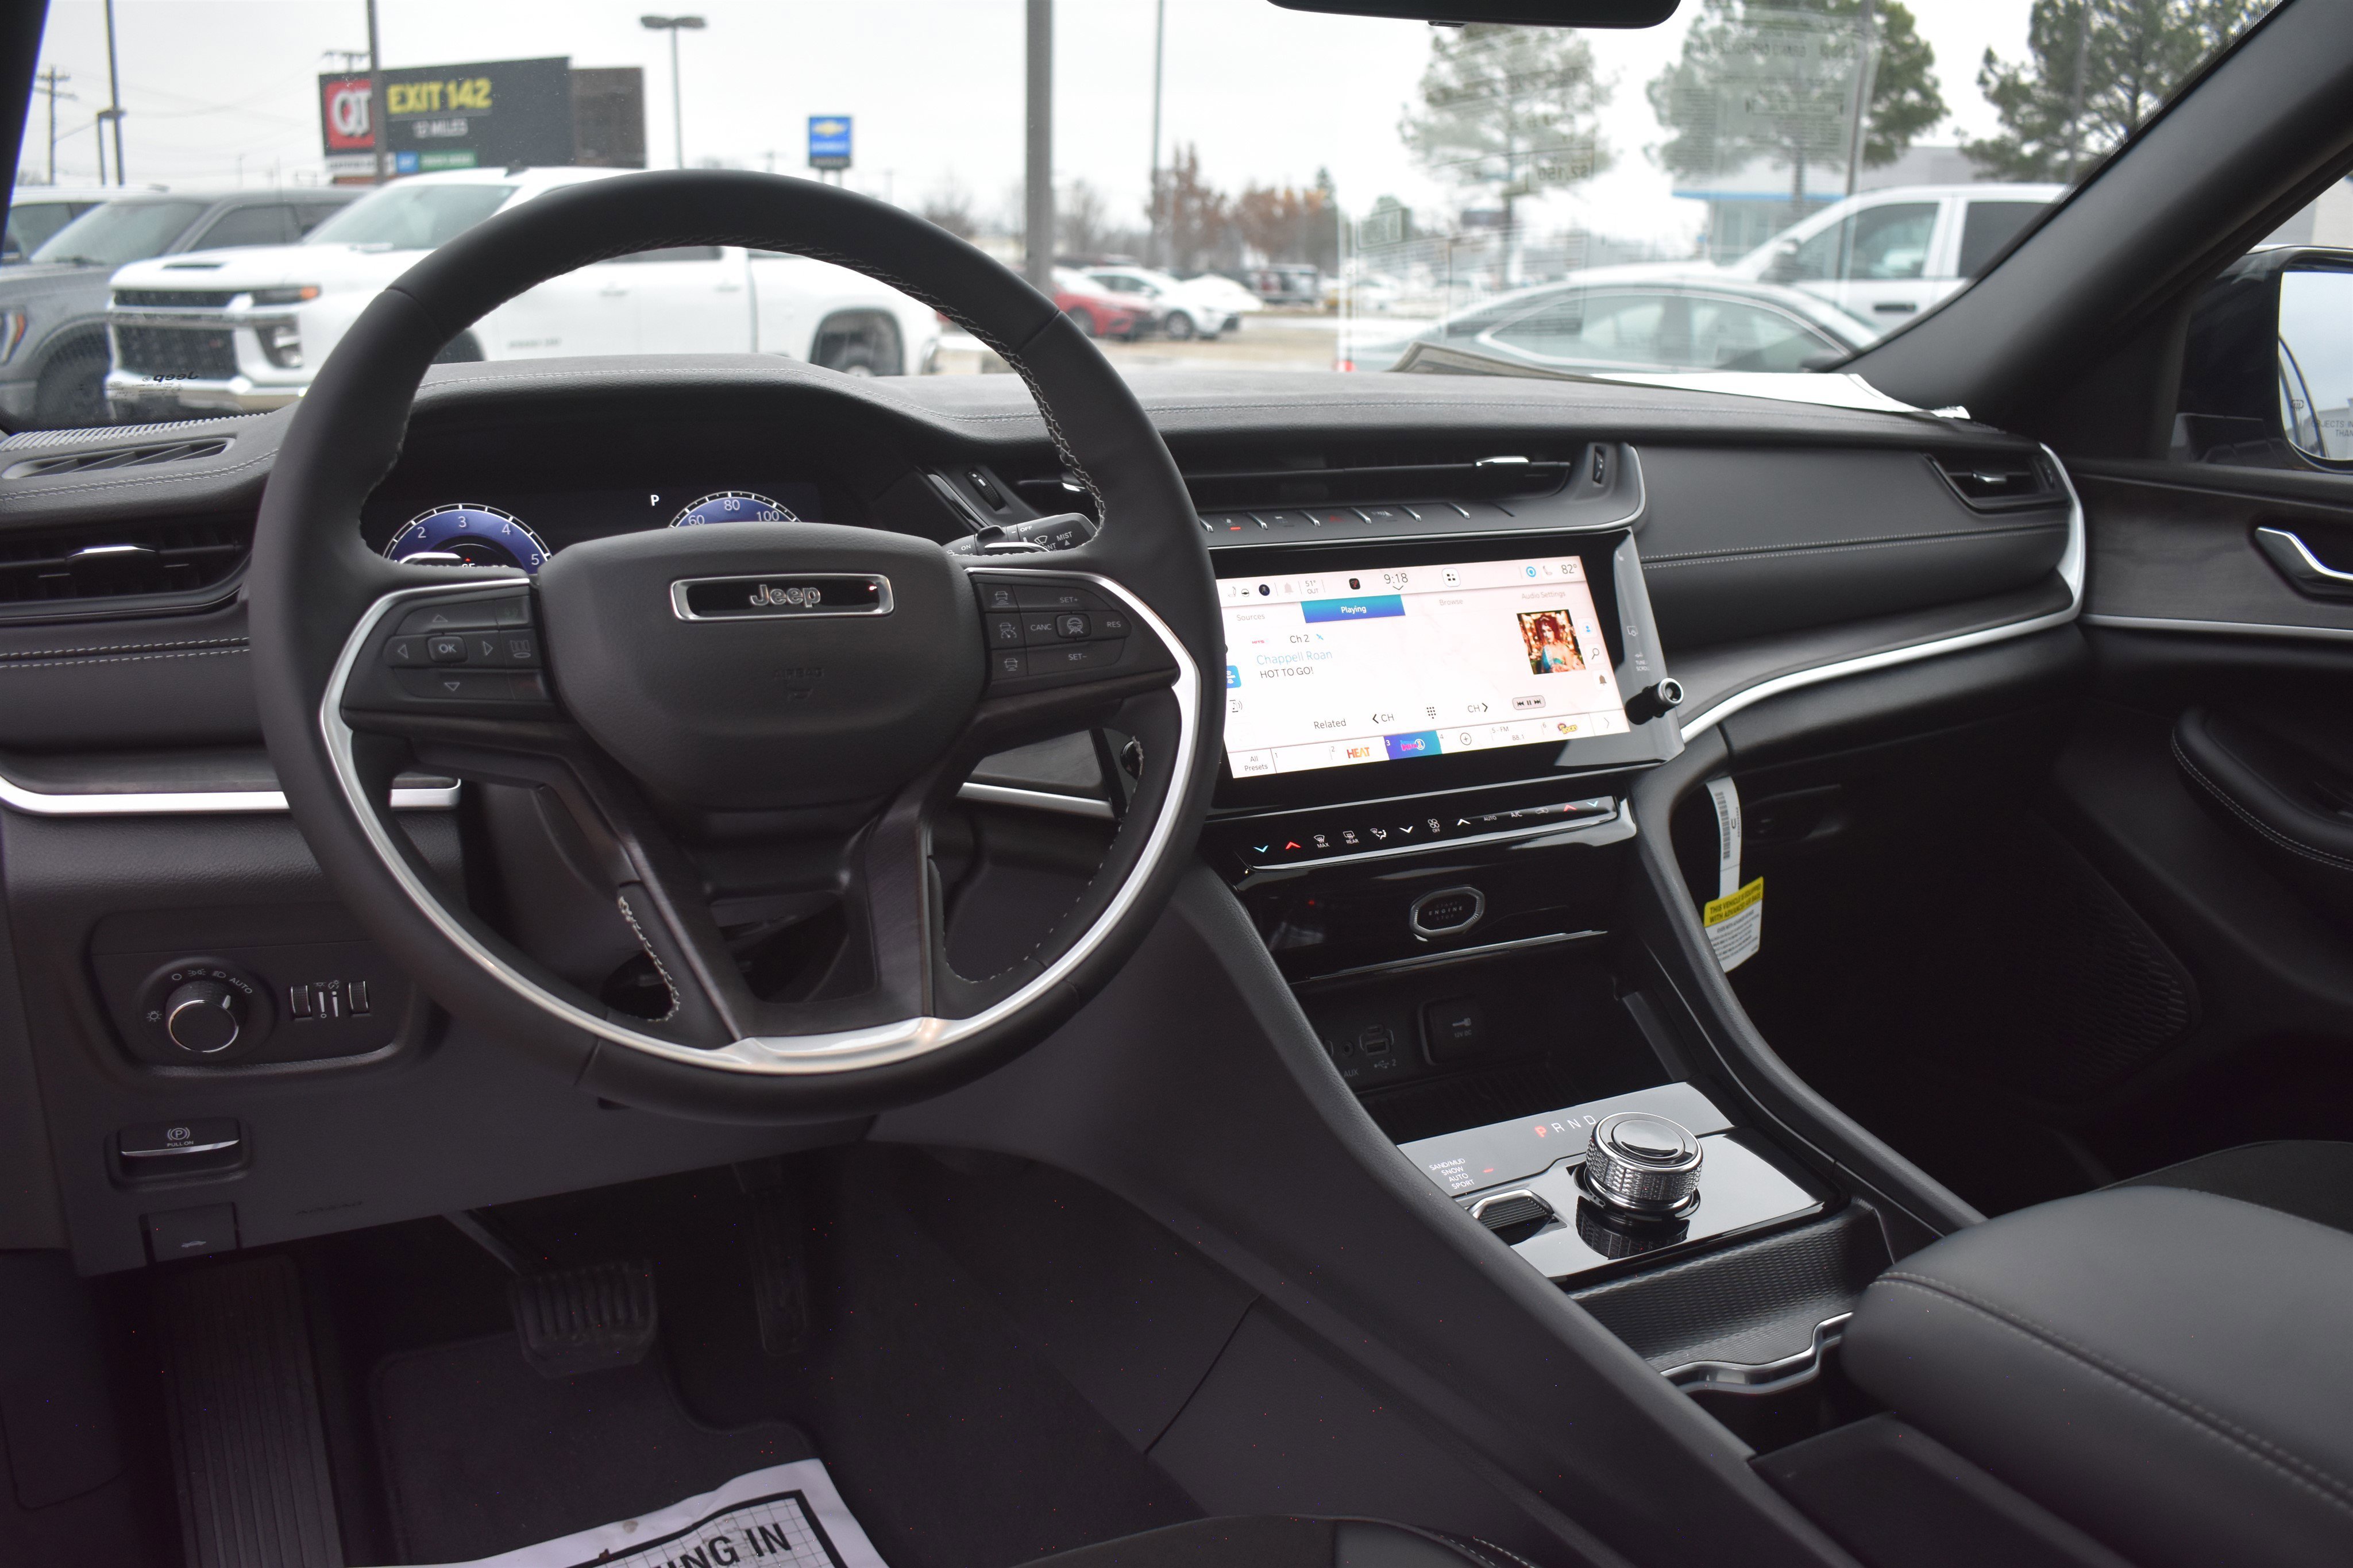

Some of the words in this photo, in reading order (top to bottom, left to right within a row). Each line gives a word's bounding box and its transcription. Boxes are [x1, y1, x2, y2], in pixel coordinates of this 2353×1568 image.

[388, 83, 443, 114] EXIT
[446, 78, 492, 111] 142
[430, 118, 468, 137] MILES
[650, 495, 659, 506] P
[724, 499, 740, 511] 80
[458, 516, 467, 528] 3
[688, 515, 705, 526] 60
[756, 511, 780, 522] 100
[417, 527, 426, 538] 2
[502, 524, 511, 535] 4
[1056, 531, 1073, 542] MIST
[531, 554, 539, 565] 5
[1383, 573, 1409, 585] 9:18
[750, 584, 821, 608] Jeep
[1522, 592, 1540, 600] Audio
[1541, 590, 1566, 599] Settings
[1340, 605, 1367, 615] Playing
[1236, 613, 1266, 621] Sources
[1030, 623, 1052, 631] CANC
[1290, 635, 1303, 644] Ch
[1304, 634, 1310, 642] 2
[438, 643, 457, 654] OK
[1256, 652, 1304, 665] Chappell
[1306, 650, 1333, 661] Roan
[1260, 669, 1279, 679] HOT
[1280, 668, 1295, 677] TO
[1295, 666, 1314, 675] GO!
[1467, 704, 1481, 713] CH
[1380, 713, 1394, 722] CH
[1313, 719, 1347, 729] Related
[1347, 747, 1370, 759] HEAT
[1244, 763, 1268, 771] Presets
[1428, 906, 1463, 916] ENGINE
[229, 978, 253, 994] AUTO
[1391, 1059, 1397, 1067] 2
[1343, 1068, 1359, 1077] AUX
[1534, 1125, 1547, 1138] P
[1550, 1122, 1565, 1133] R
[1567, 1118, 1581, 1129] N
[1583, 1115, 1596, 1125] D
[1429, 1158, 1465, 1171] SAND/MUD
[1441, 1165, 1464, 1176] SNOW
[1448, 1173, 1469, 1182] AUTO
[1451, 1179, 1475, 1189] SPORT
[746, 1522, 792, 1557] IN
